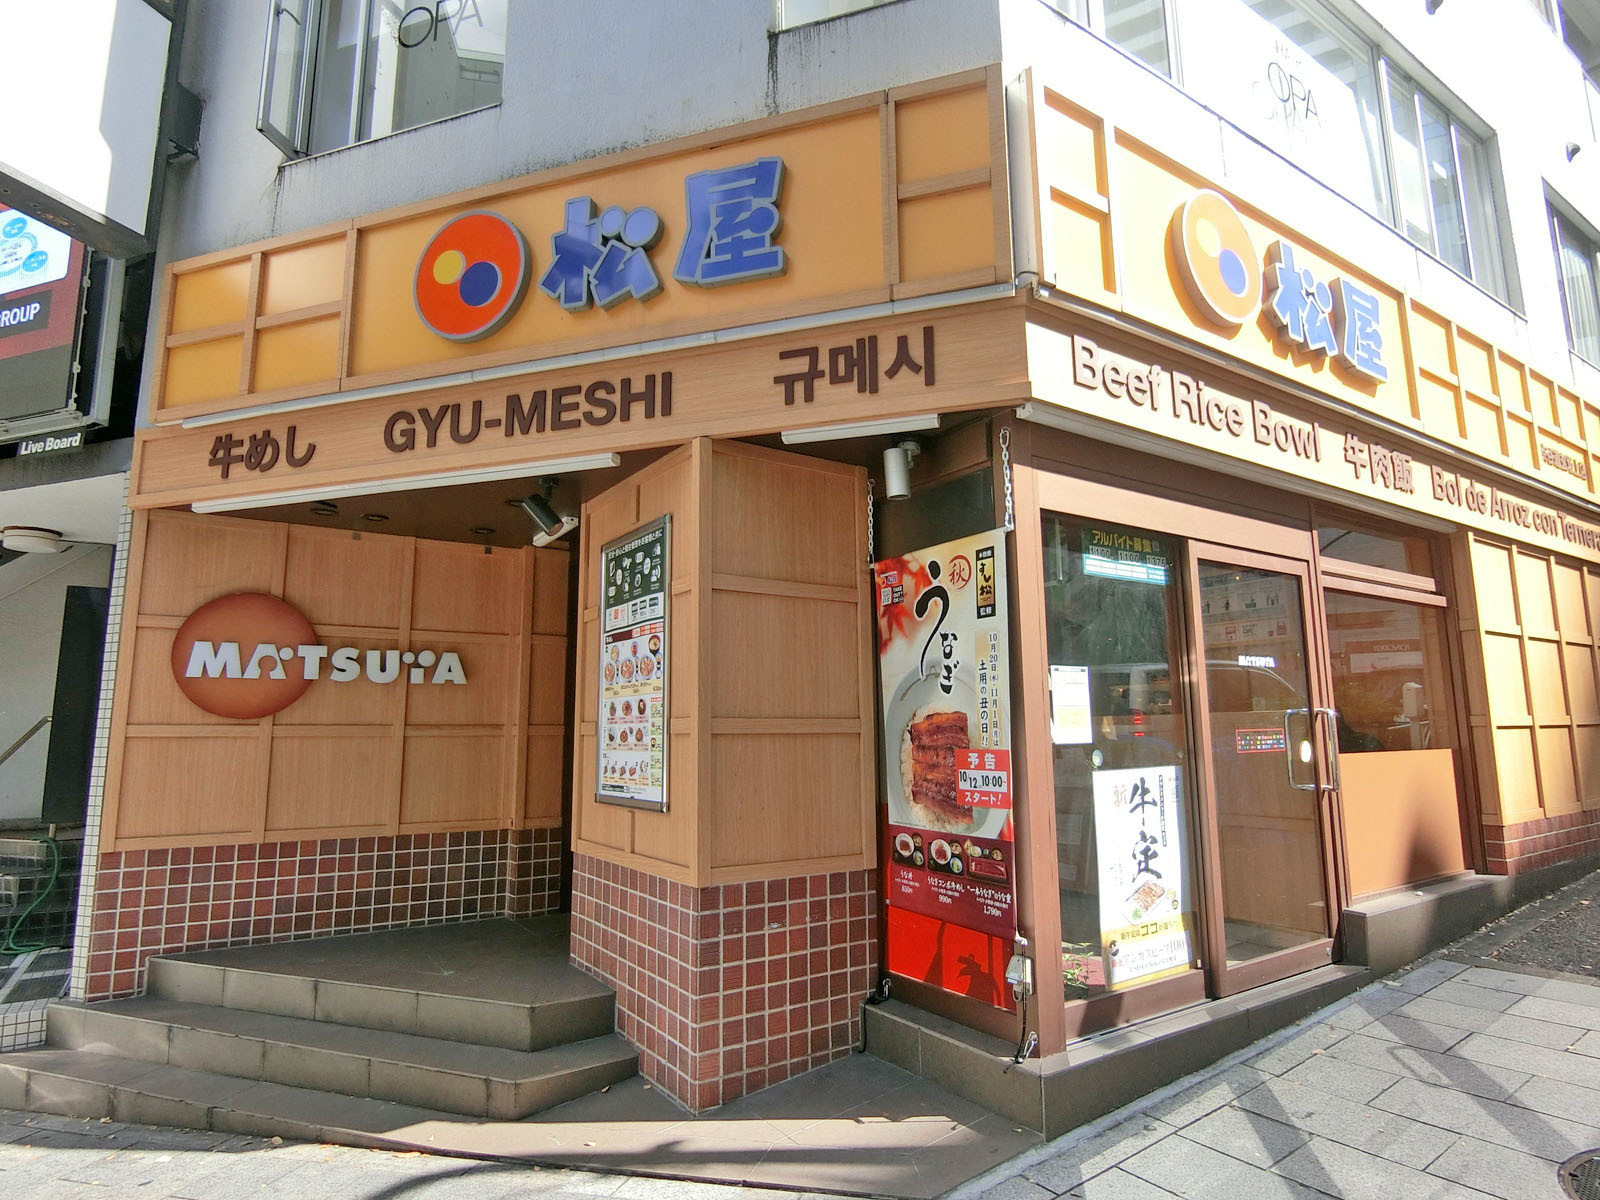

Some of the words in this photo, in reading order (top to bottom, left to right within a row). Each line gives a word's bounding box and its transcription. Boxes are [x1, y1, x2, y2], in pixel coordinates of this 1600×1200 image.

[398, 0, 484, 48] OPA
[537, 157, 788, 312] 松屋
[0, 302, 41, 328] ROUP
[1265, 240, 1389, 384] 松屋
[772, 325, 936, 406] 규메시
[1071, 333, 1162, 411] Beef
[1171, 370, 1245, 437] Rice
[1252, 399, 1321, 463] Bowl
[20, 436, 45, 456] Live
[45, 432, 82, 453] Board
[383, 370, 673, 453] GYU-MESHI
[208, 425, 317, 481] 牛めし
[1343, 431, 1415, 495] 牛肉飯
[1430, 464, 1463, 507] Bol
[1465, 479, 1488, 515] de
[1490, 487, 1531, 528] Arroz
[1533, 510, 1558, 537] con
[185, 640, 468, 685] MATSUYA
[915, 560, 960, 695] うなぎ
[967, 752, 996, 770] 予告
[1128, 776, 1163, 883] 牛定
